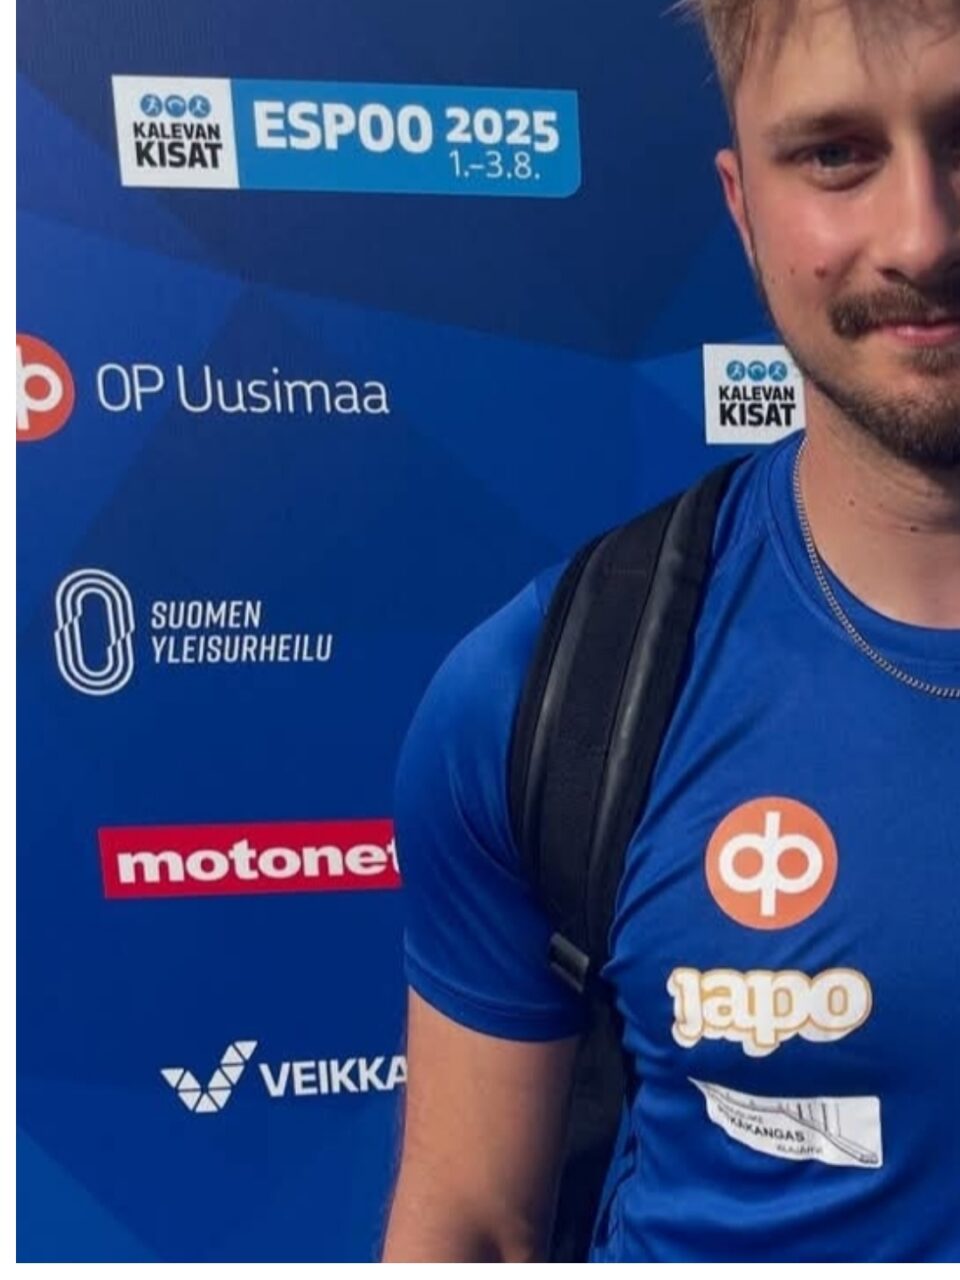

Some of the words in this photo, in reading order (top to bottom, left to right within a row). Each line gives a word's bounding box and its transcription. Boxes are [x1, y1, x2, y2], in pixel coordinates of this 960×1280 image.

[133, 121, 222, 144] KALEVAN
[253, 100, 434, 154] ESPOO
[445, 106, 561, 153] 2025
[135, 141, 223, 170] KISAT
[97, 363, 164, 413] OP
[177, 365, 390, 416] Uusimaa
[719, 385, 796, 404] KALEVAN
[719, 402, 797, 428] KISAT
[151, 599, 262, 629] SUOMEN
[150, 633, 334, 665] YLEISURHEILU
